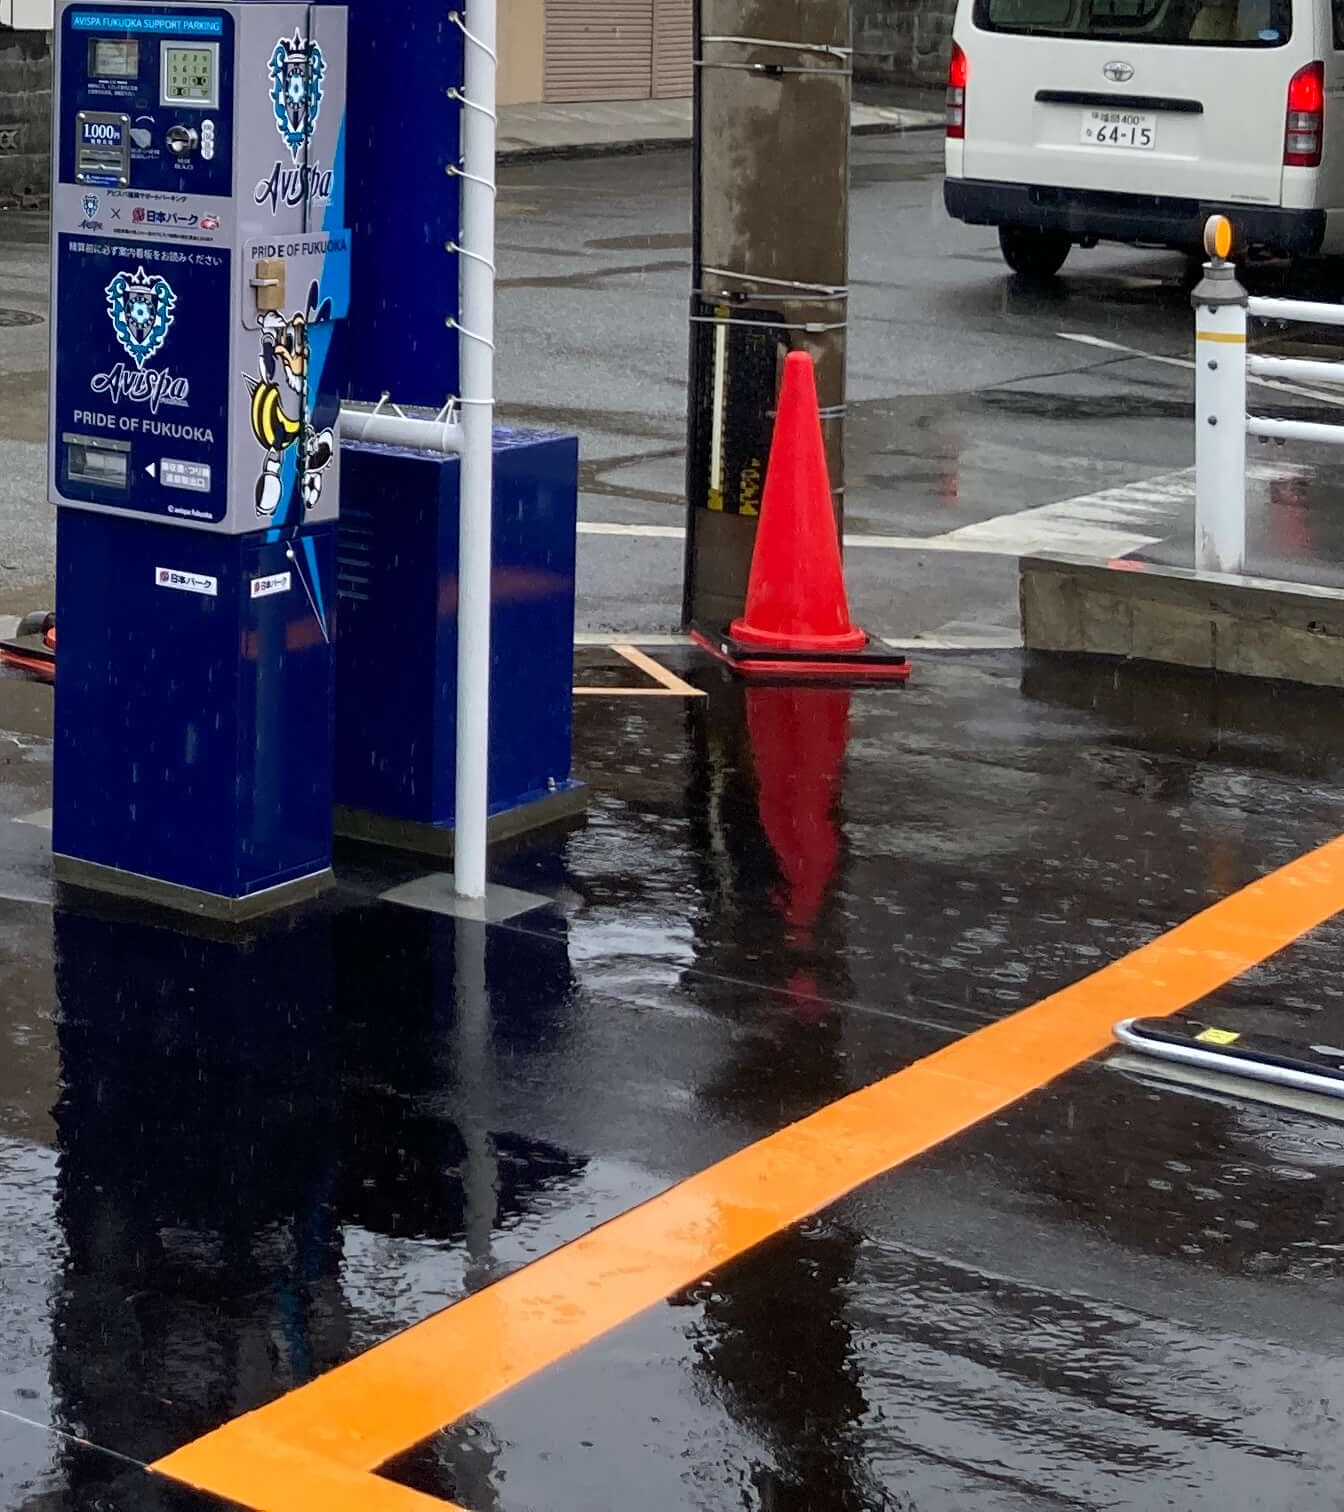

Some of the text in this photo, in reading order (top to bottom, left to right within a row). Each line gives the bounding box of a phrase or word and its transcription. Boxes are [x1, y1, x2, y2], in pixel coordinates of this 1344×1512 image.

[73, 16, 221, 32] AVISPA FUKUOKA SUPPORT PARKING
[1096, 125, 1152, 146] 64-15
[146, 210, 200, 226] 日本パーク
[251, 238, 347, 259] PRIDE OF FUKUOKA
[73, 409, 215, 443] PRIDE OF FUKUOKA
[170, 572, 213, 589] 日本パーク
